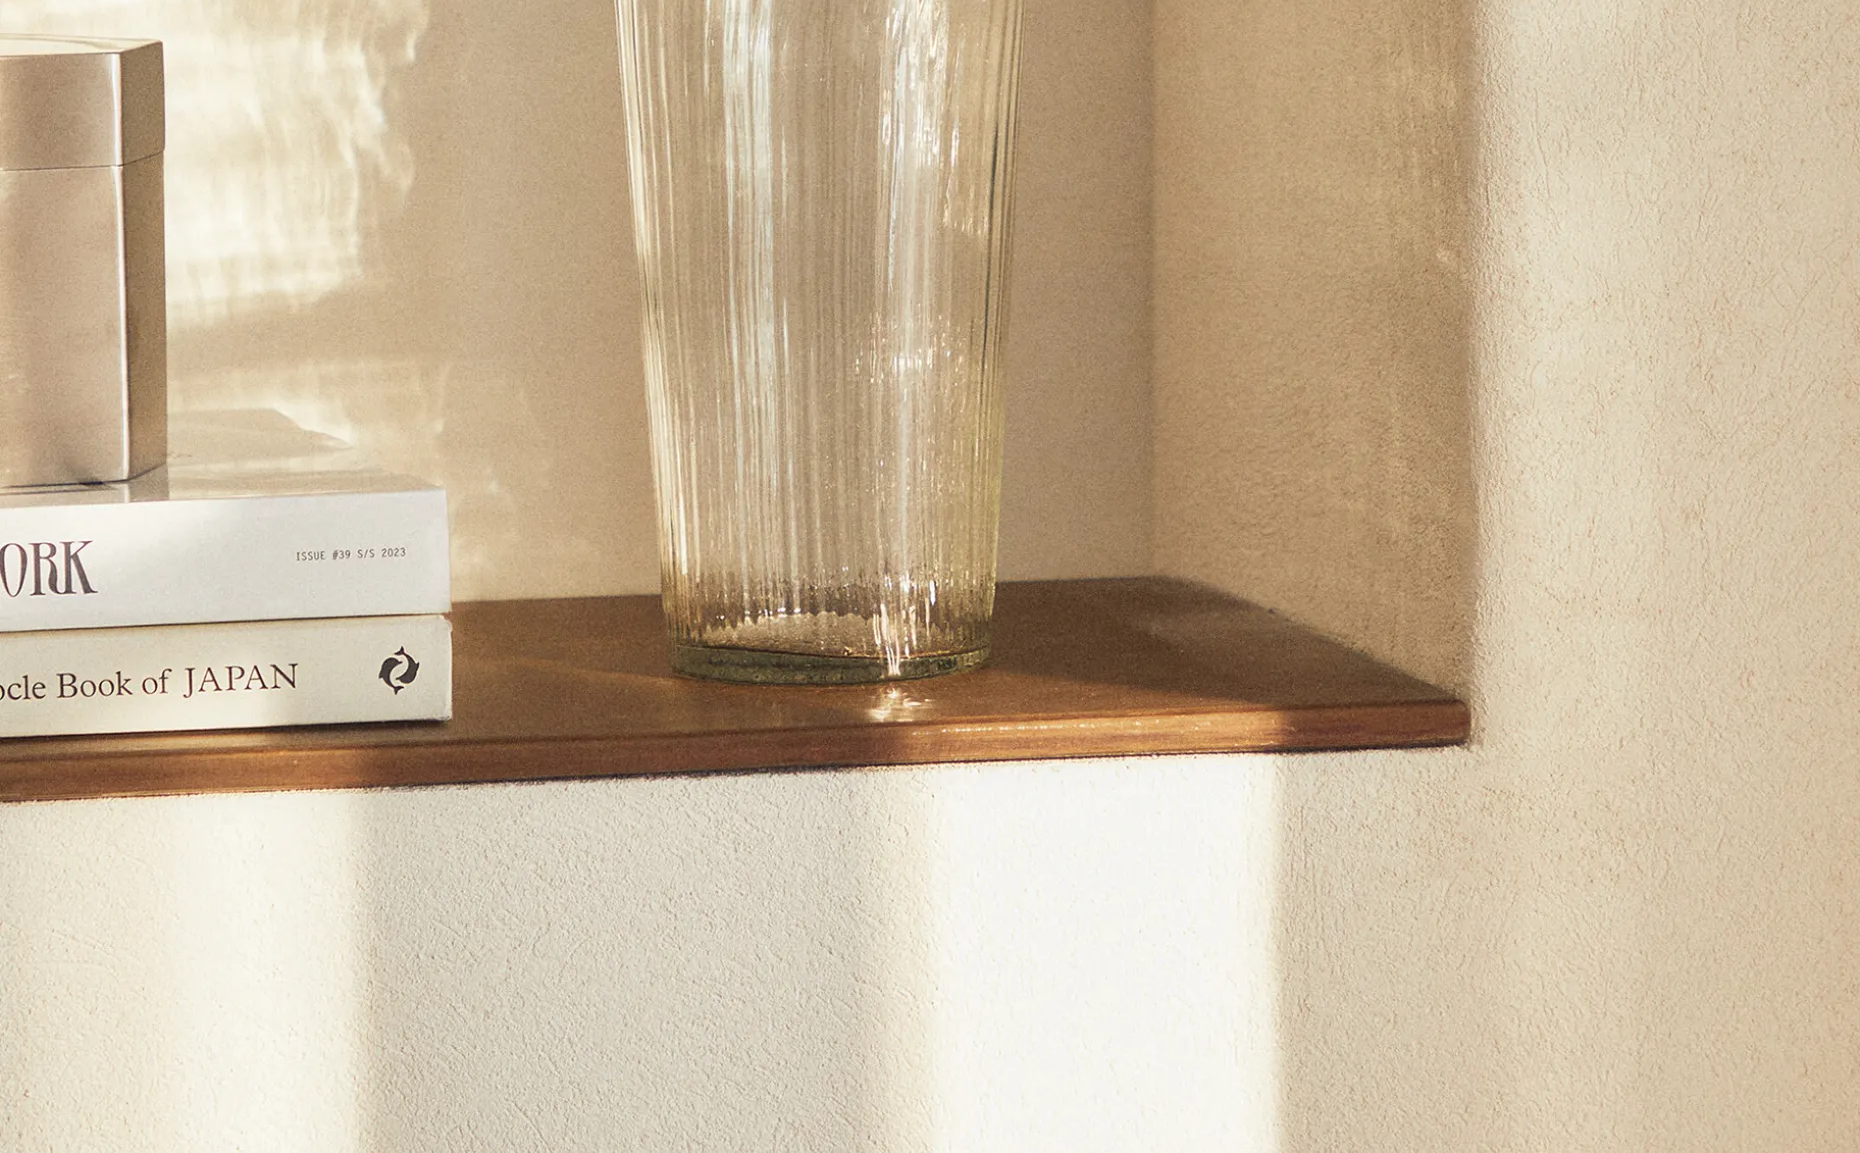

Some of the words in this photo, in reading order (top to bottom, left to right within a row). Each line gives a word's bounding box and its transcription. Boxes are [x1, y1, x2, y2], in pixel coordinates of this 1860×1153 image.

[296, 550, 326, 562] ISSUE
[332, 549, 351, 561] #39
[357, 548, 375, 559] S/S
[381, 547, 406, 558] 2023
[56, 671, 133, 698] Book
[142, 668, 173, 695] of
[183, 662, 299, 698] JAPAN
